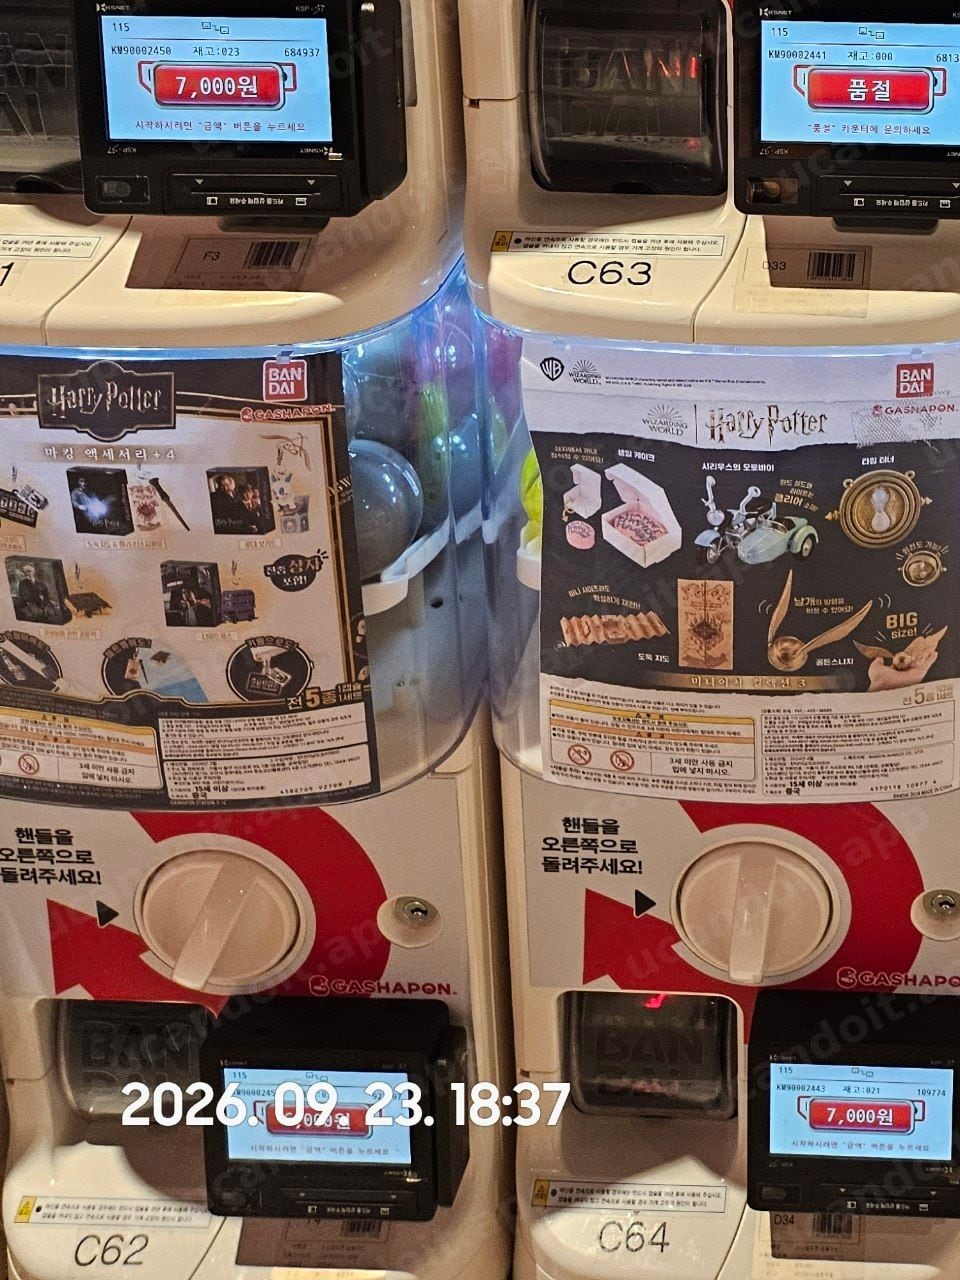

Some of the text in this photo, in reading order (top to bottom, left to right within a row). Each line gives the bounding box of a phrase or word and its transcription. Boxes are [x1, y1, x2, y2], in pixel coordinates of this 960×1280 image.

[112, 22, 129, 32] 115
[772, 27, 788, 36] 115
[111, 45, 172, 56] KM90002450
[284, 47, 320, 57] 684937
[768, 51, 827, 60] KM90002441
[175, 76, 258, 99] 7,000원
[848, 80, 891, 102] 품절
[567, 260, 652, 286] C63
[269, 368, 302, 381] BAN
[900, 368, 931, 382] BAN
[268, 381, 295, 395] DAI
[900, 382, 925, 394] DAI
[48, 381, 161, 419] Harry Potter
[648, 427, 684, 436] WORLD
[705, 405, 828, 445] Harry Potter
[634, 451, 655, 462] 케이크
[886, 612, 918, 629] BIG
[891, 627, 917, 639] size!
[562, 816, 620, 834] 핸들을
[15, 828, 73, 846] 핸들을
[541, 836, 638, 855] 오른쪽으로
[0, 847, 95, 865] 오른쪽으로
[541, 855, 643, 875] 돌려주세요!
[1, 868, 102, 886] 돌려주세요!
[779, 1067, 793, 1075] 115
[826, 1106, 894, 1126] 7,000원
[599, 1221, 670, 1253] C64
[74, 1234, 149, 1266] C62
